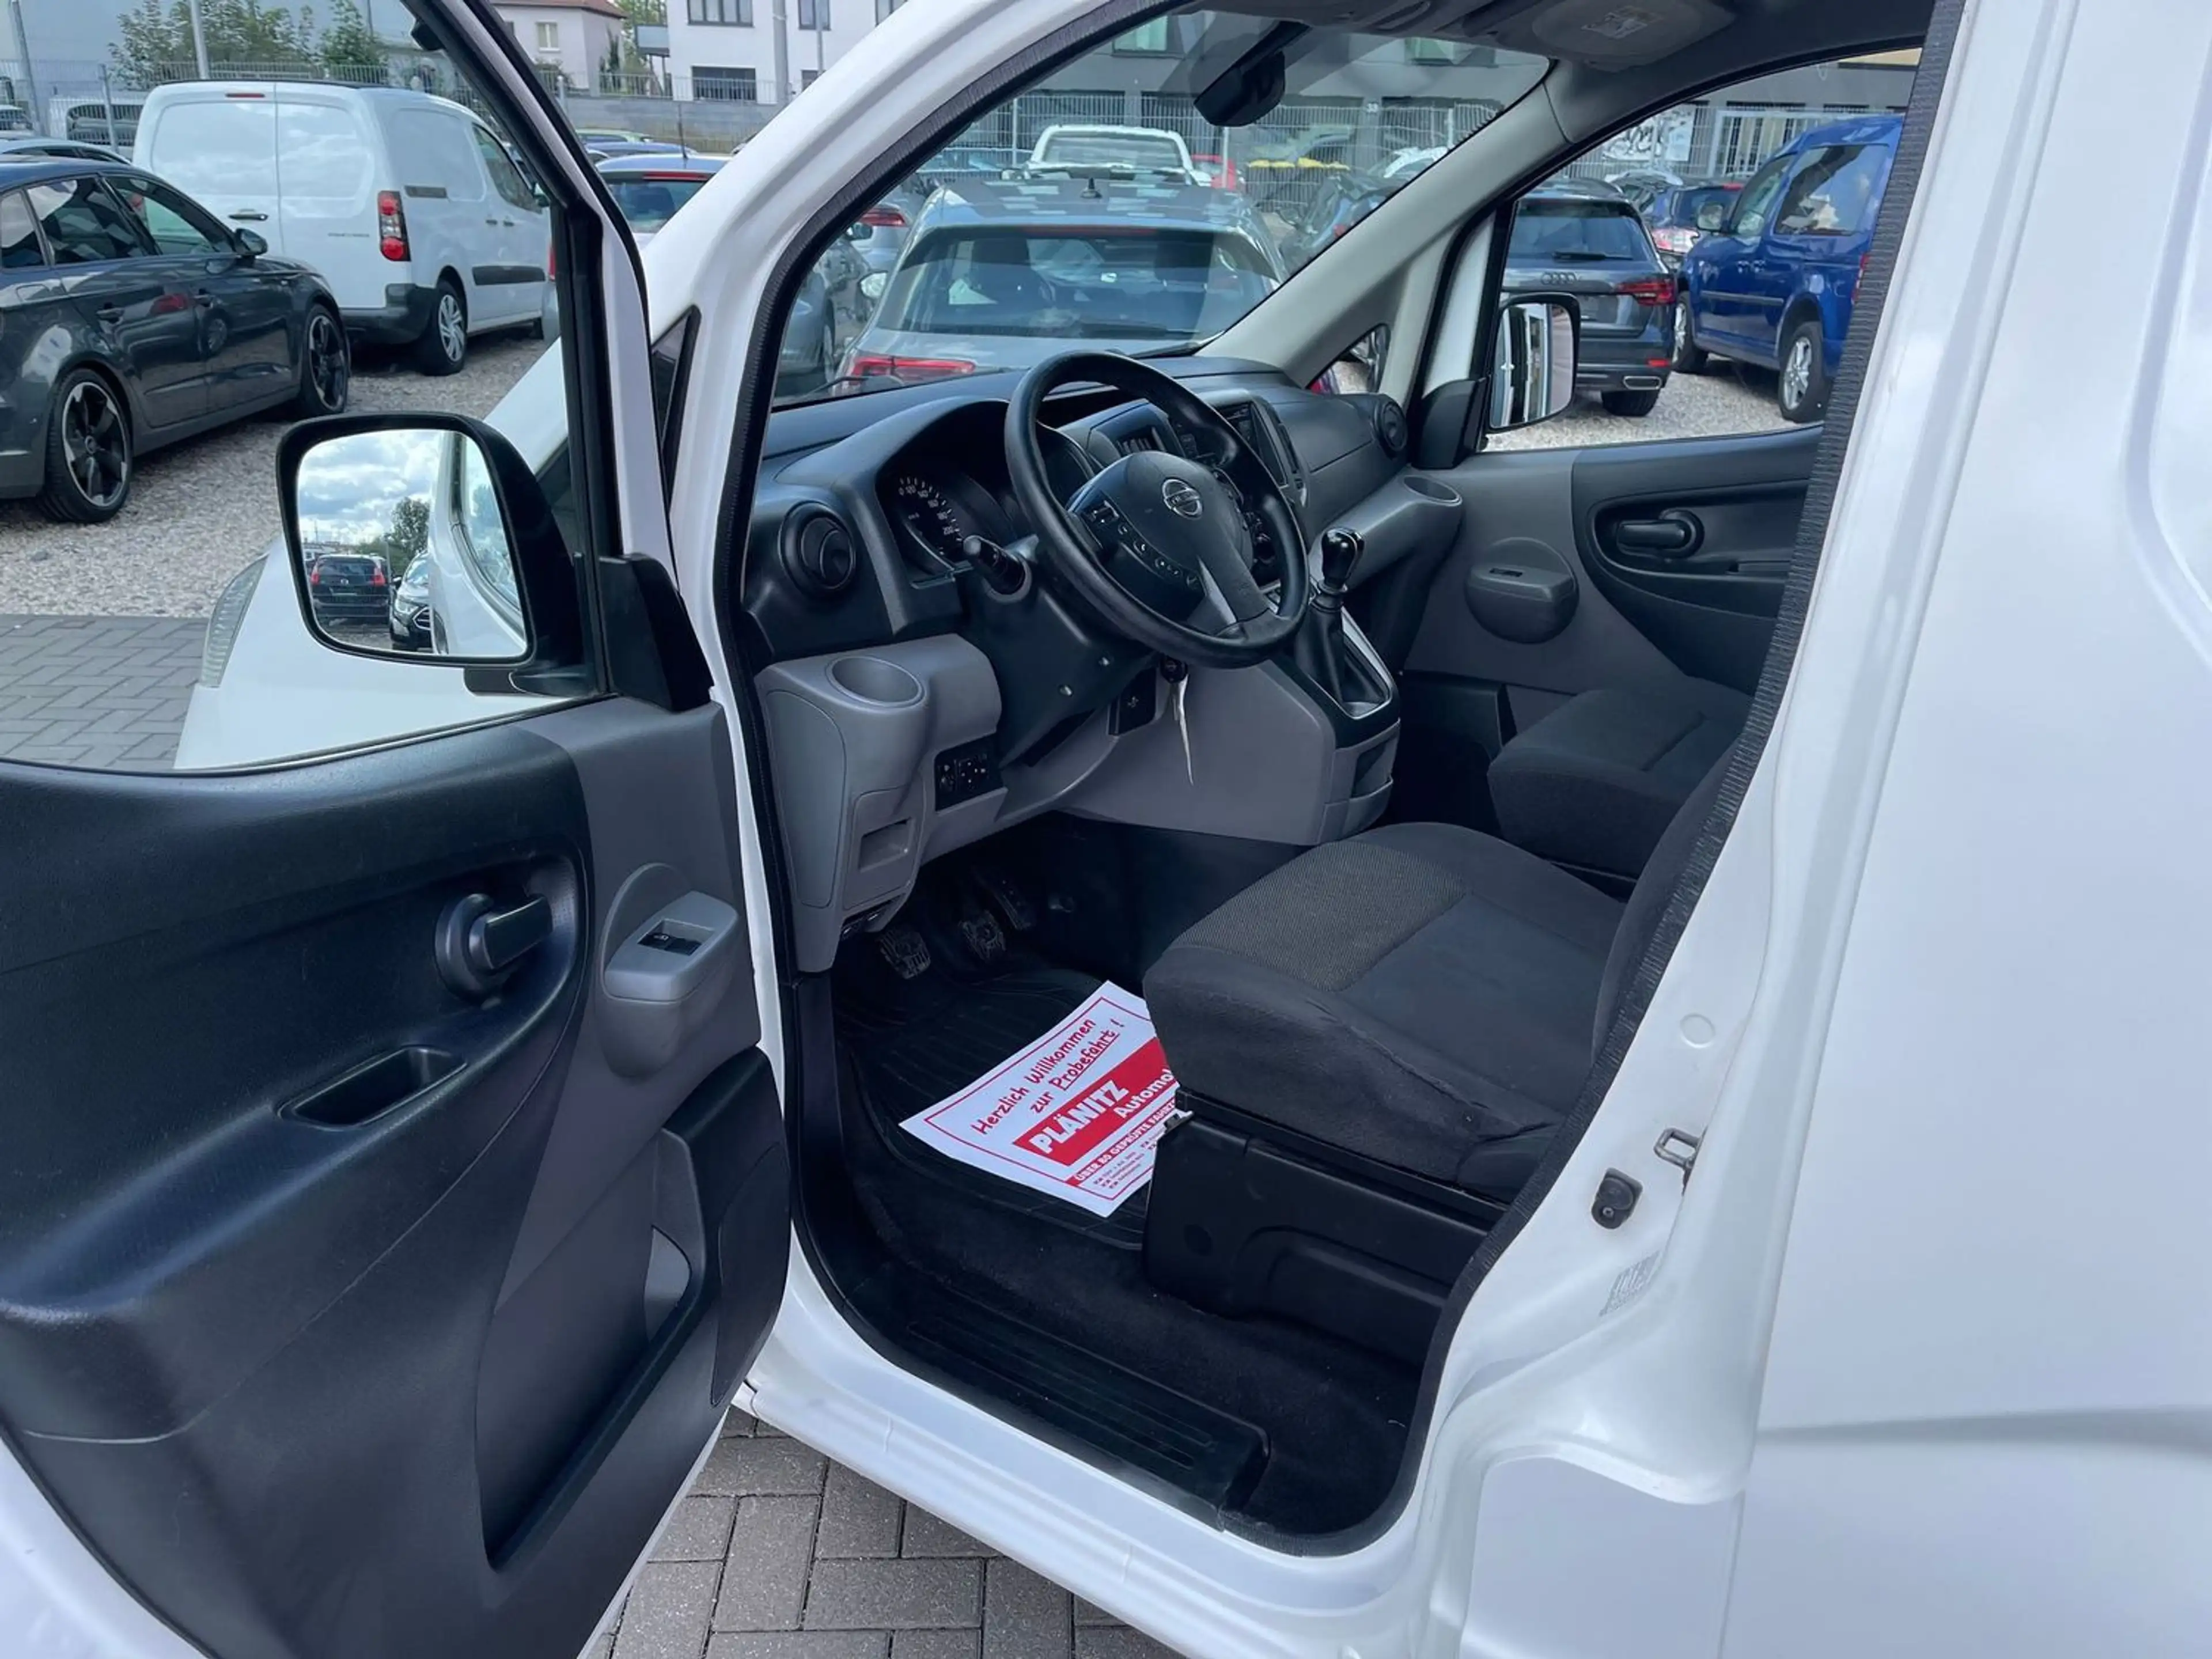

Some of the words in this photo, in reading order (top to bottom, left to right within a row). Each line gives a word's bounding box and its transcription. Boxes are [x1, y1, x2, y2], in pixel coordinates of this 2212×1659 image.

[971, 1086, 1029, 1135] Herzlich
[1024, 1018, 1096, 1085] Willkommen
[1029, 1092, 1054, 1114] zur
[1048, 1029, 1116, 1091] Probefahrt
[1028, 1080, 1130, 1154] PLÄNITZ
